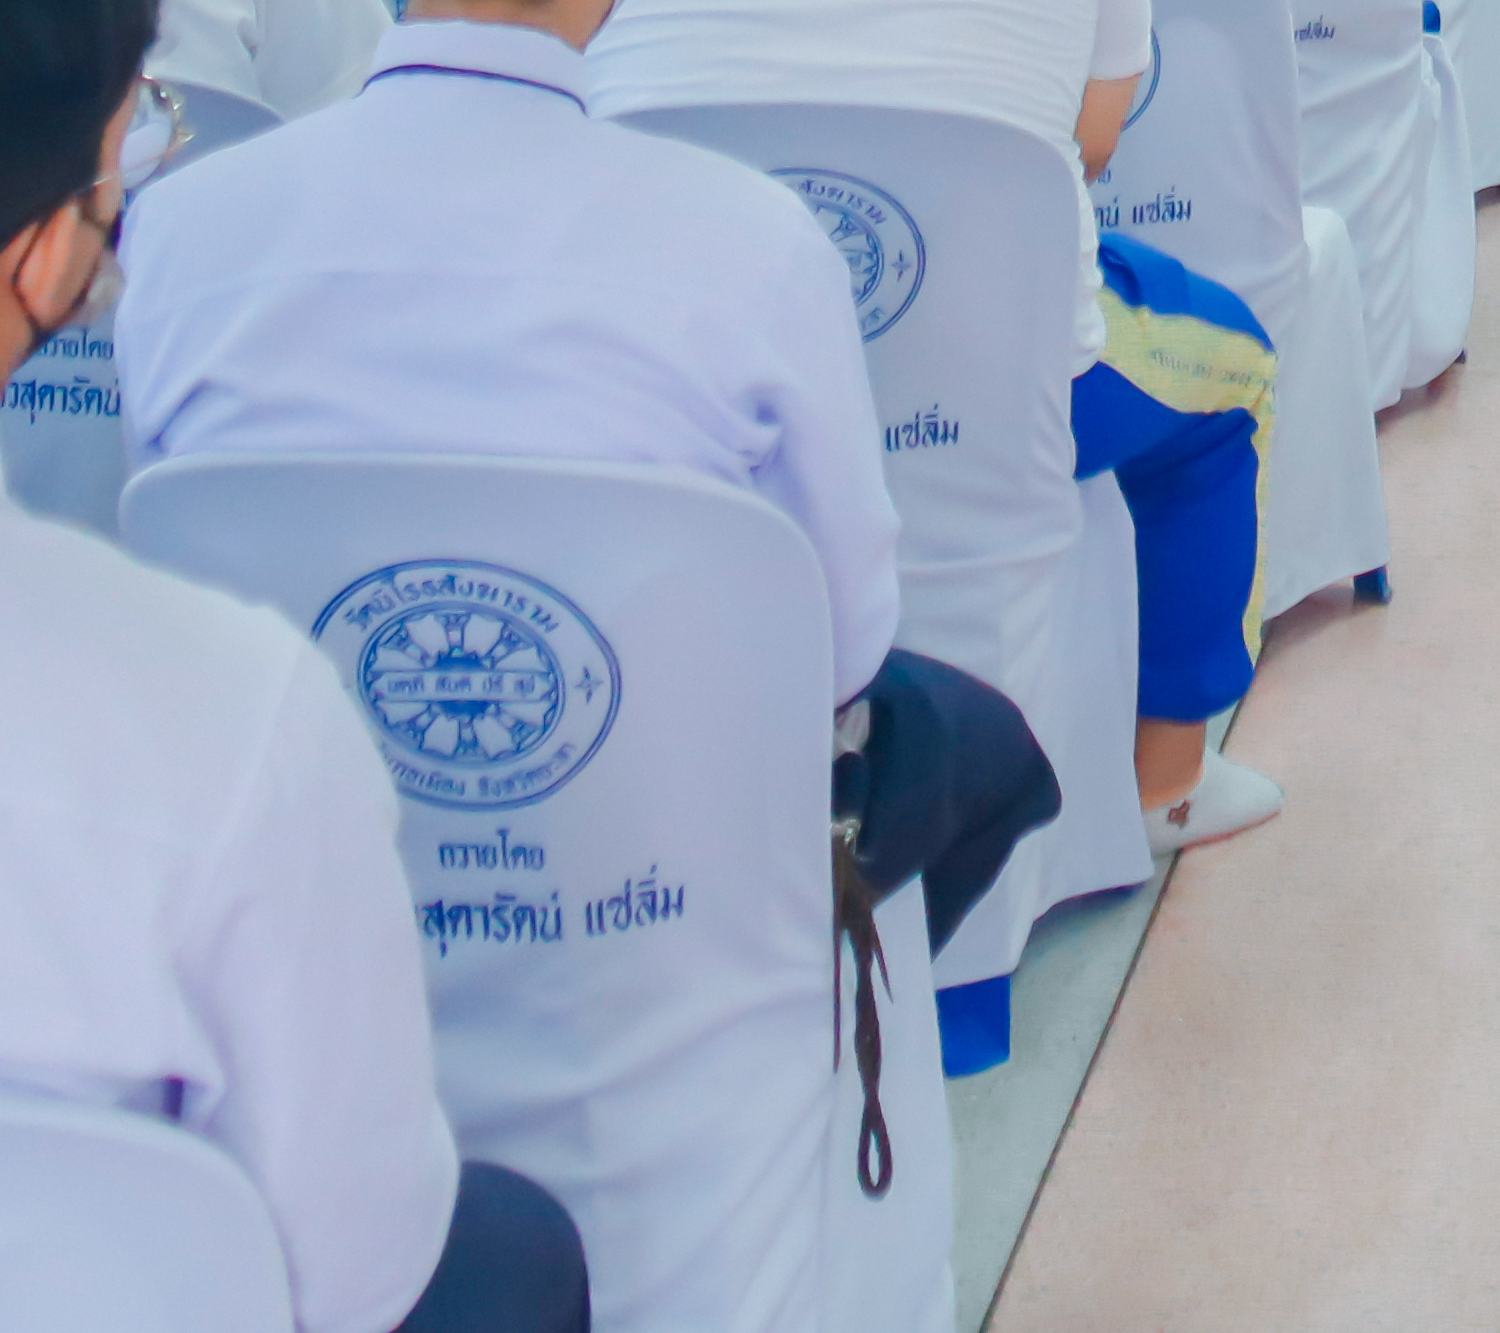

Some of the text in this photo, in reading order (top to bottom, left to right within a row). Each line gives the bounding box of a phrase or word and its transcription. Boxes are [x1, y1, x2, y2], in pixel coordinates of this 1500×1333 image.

[438, 828, 546, 871] ถวายโดย
[584, 864, 686, 938] แซ่ลิ่ม
